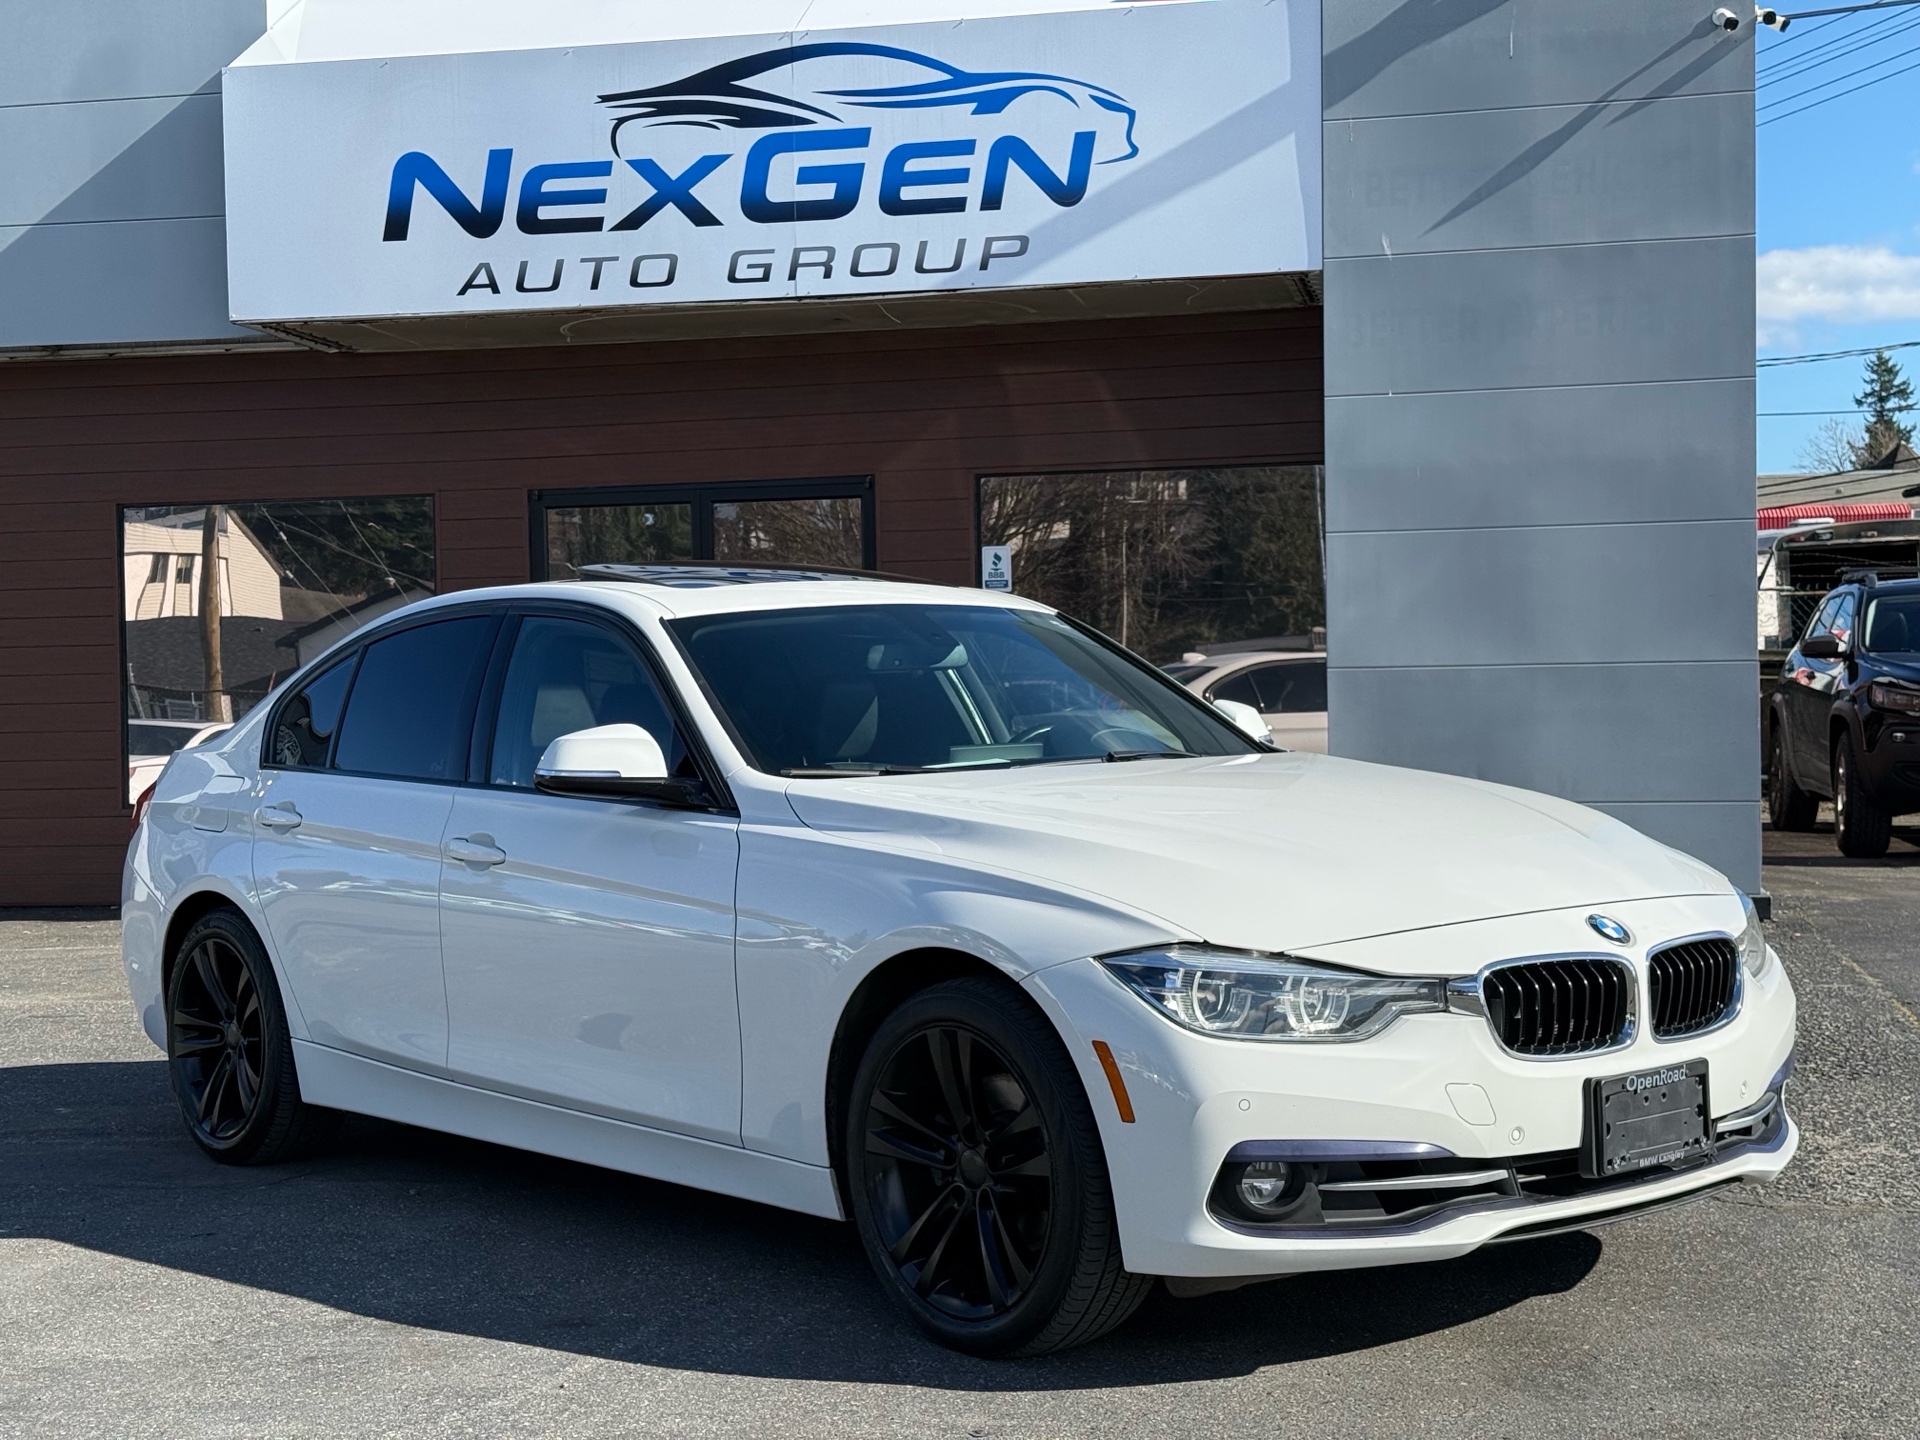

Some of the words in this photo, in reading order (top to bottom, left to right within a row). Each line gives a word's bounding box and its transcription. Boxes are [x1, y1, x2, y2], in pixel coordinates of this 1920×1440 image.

[456, 253, 679, 297] AUTO
[727, 234, 1030, 285] GROUP
[1626, 1064, 1686, 1093] OpenRoad
[1639, 1154, 1659, 1167] BMW
[1659, 1151, 1684, 1162] Langley
